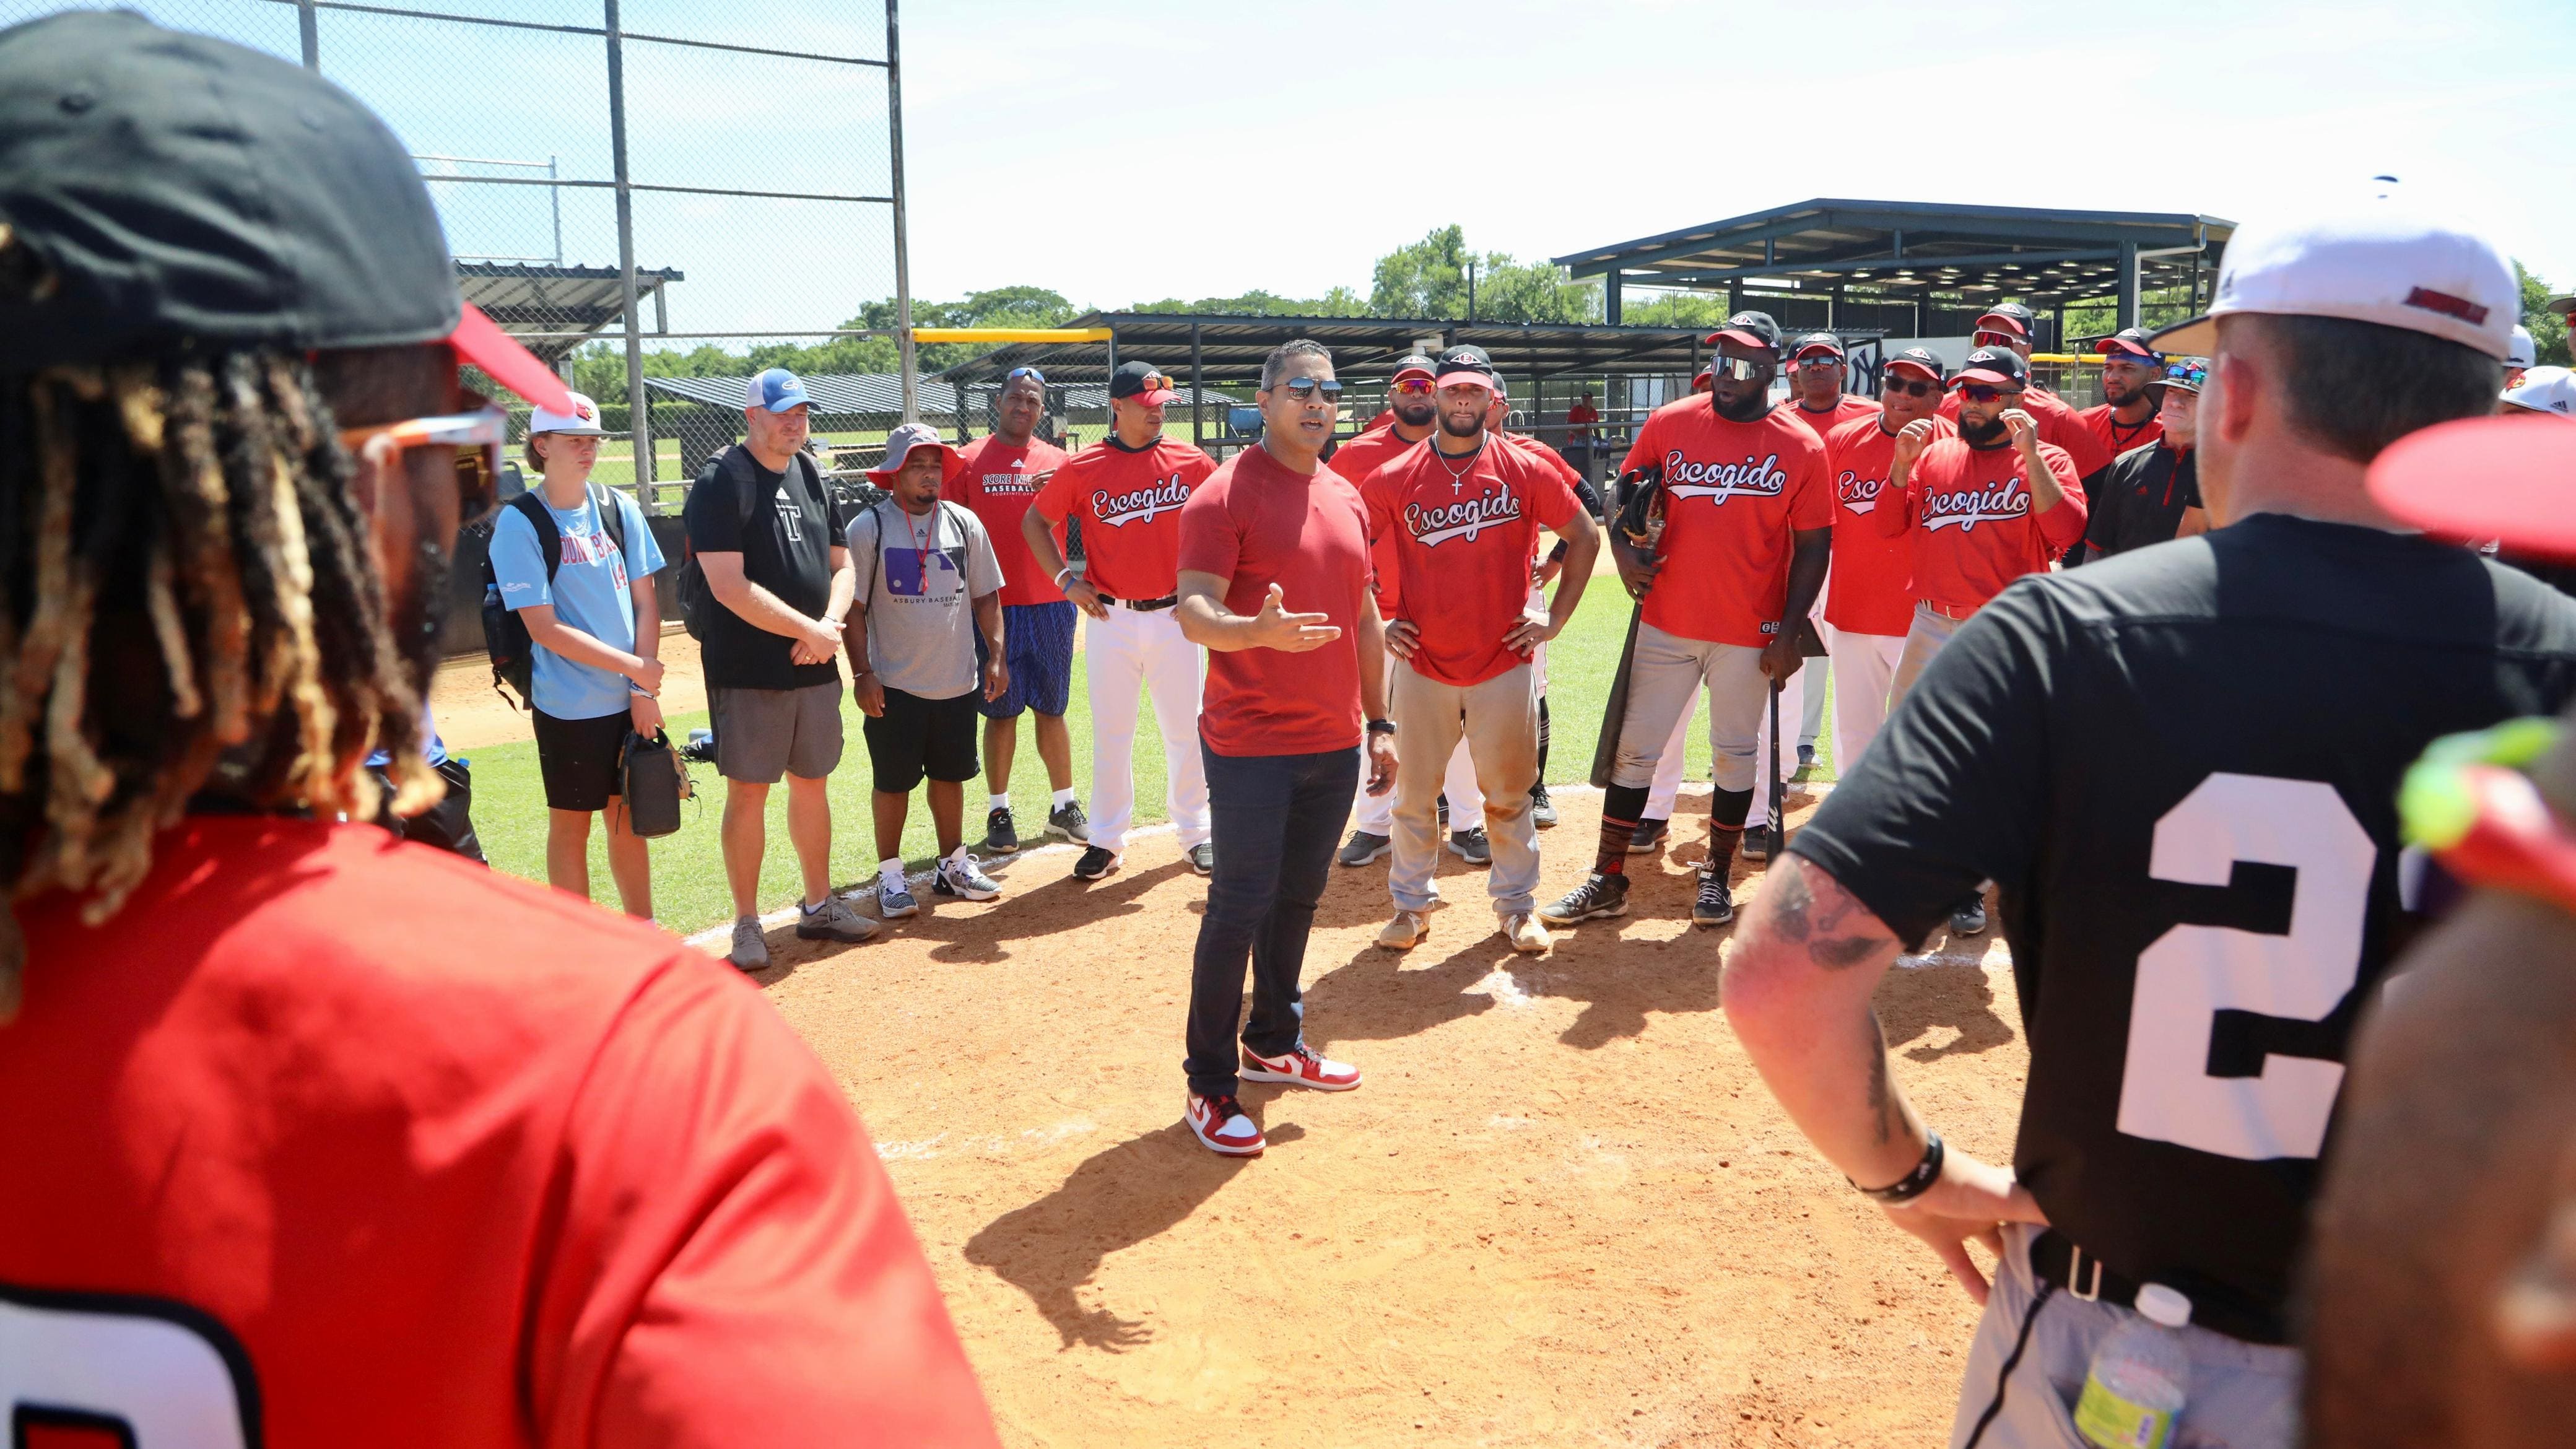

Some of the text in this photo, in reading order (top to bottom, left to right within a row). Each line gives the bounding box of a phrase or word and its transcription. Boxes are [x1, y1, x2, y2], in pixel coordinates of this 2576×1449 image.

[983, 474, 1012, 485] SCORE
[1092, 473, 1190, 524] Escogido
[1664, 450, 1786, 506] Escogido
[775, 505, 801, 541] T
[1404, 484, 1520, 542] Escogido
[2117, 772, 2415, 1160] 2
